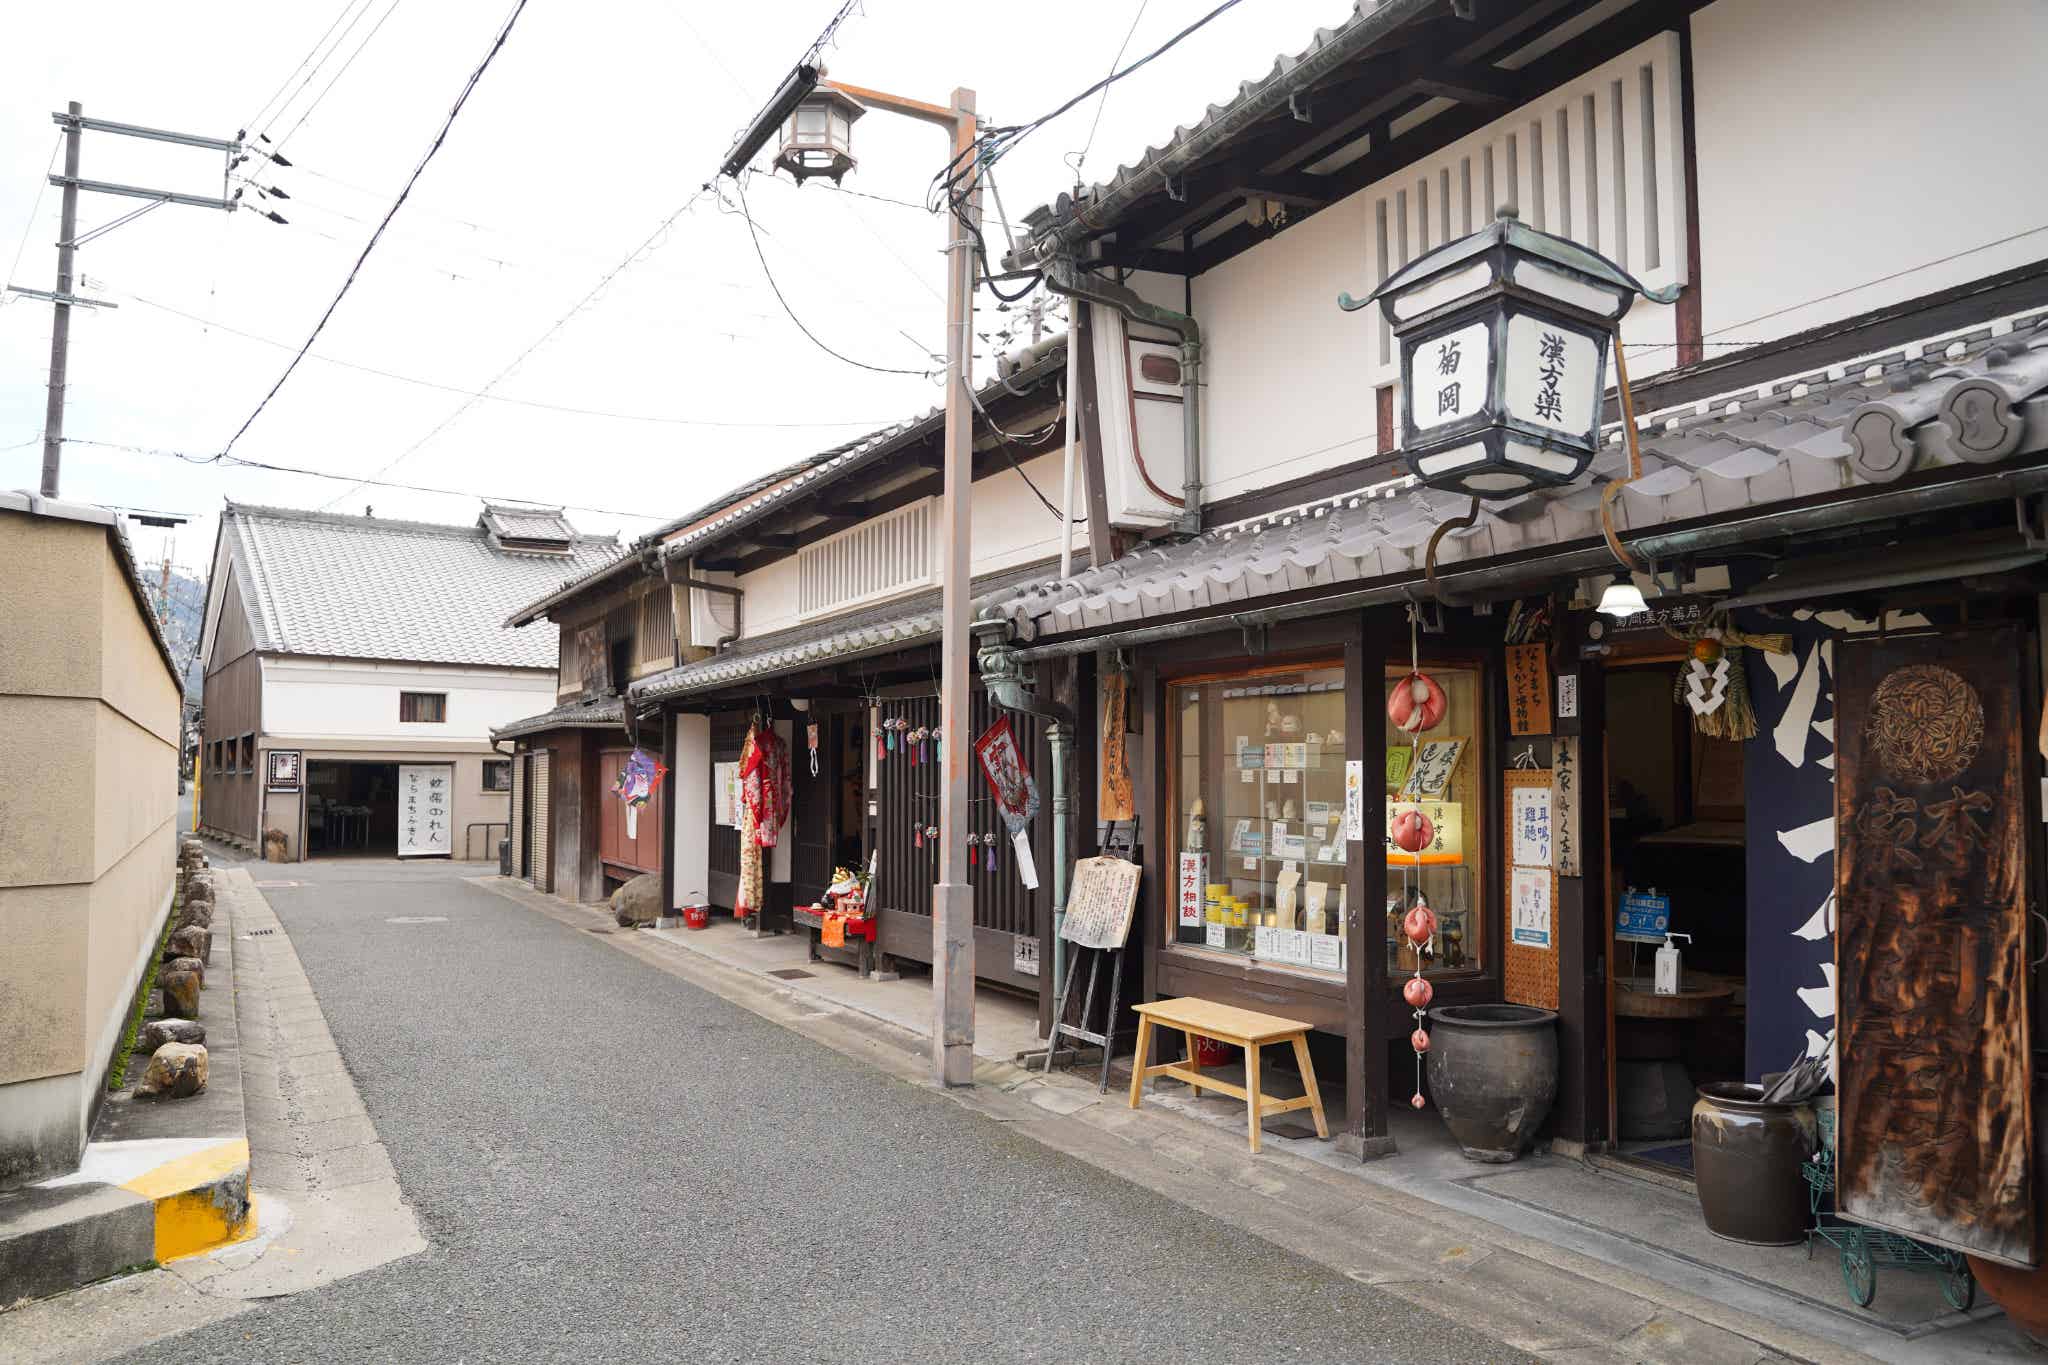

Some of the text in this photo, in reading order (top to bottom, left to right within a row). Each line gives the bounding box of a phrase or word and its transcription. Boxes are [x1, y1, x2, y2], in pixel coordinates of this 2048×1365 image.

[1438, 340, 1461, 416] 菊岡
[1524, 806, 1537, 842] 難聴
[1538, 806, 1549, 860] 耳鳴り
[1183, 859, 1198, 918] 漢方相談
